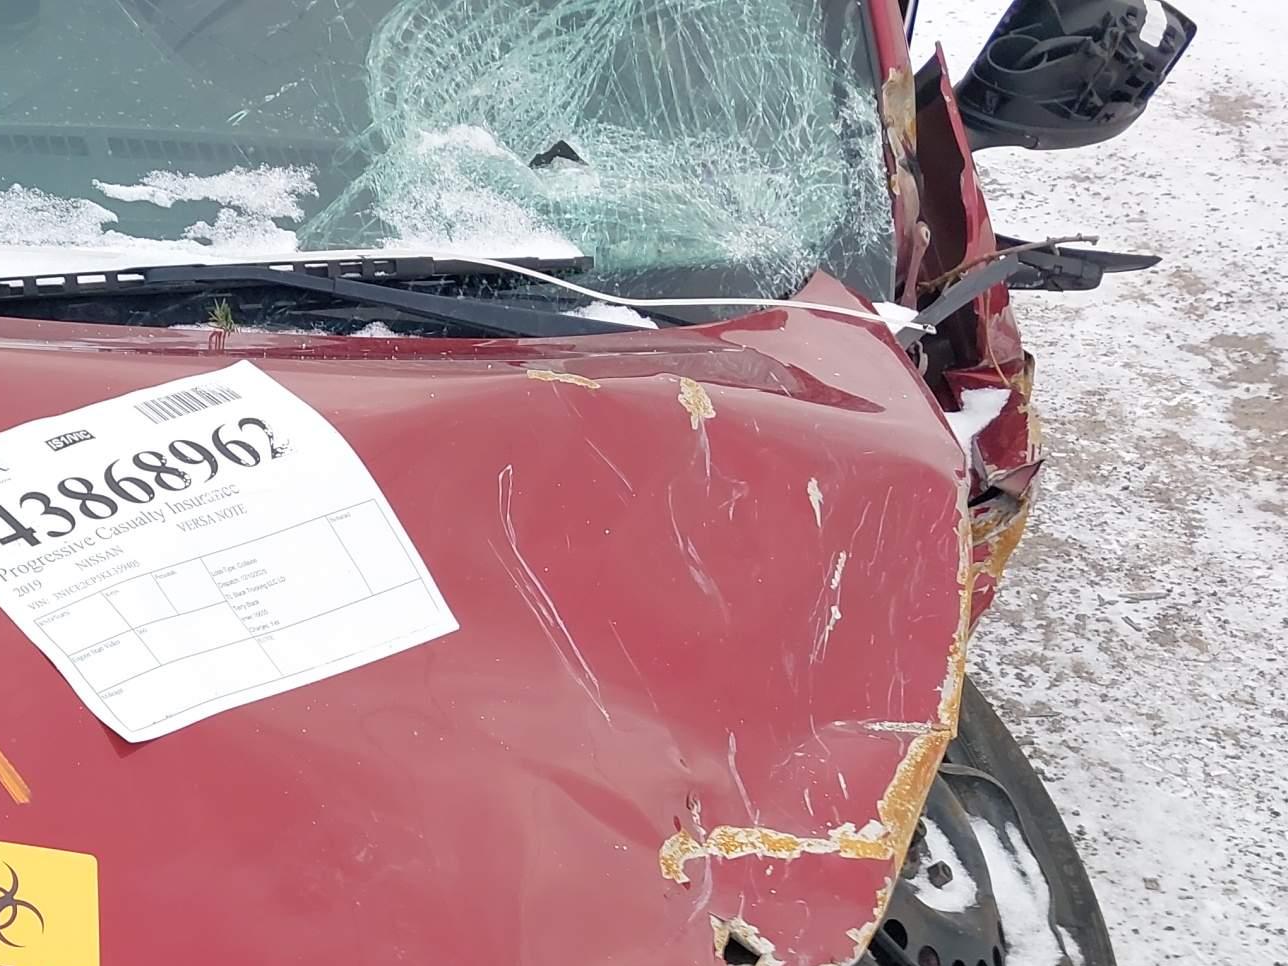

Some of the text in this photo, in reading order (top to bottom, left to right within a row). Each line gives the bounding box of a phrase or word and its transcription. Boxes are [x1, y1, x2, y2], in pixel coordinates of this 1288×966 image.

[95, 508, 166, 540] Casualty
[164, 484, 240, 515] Insurance
[175, 502, 248, 533] VERSA NOTE
[74, 544, 124, 571] NISSAN
[13, 578, 43, 598] 2019
